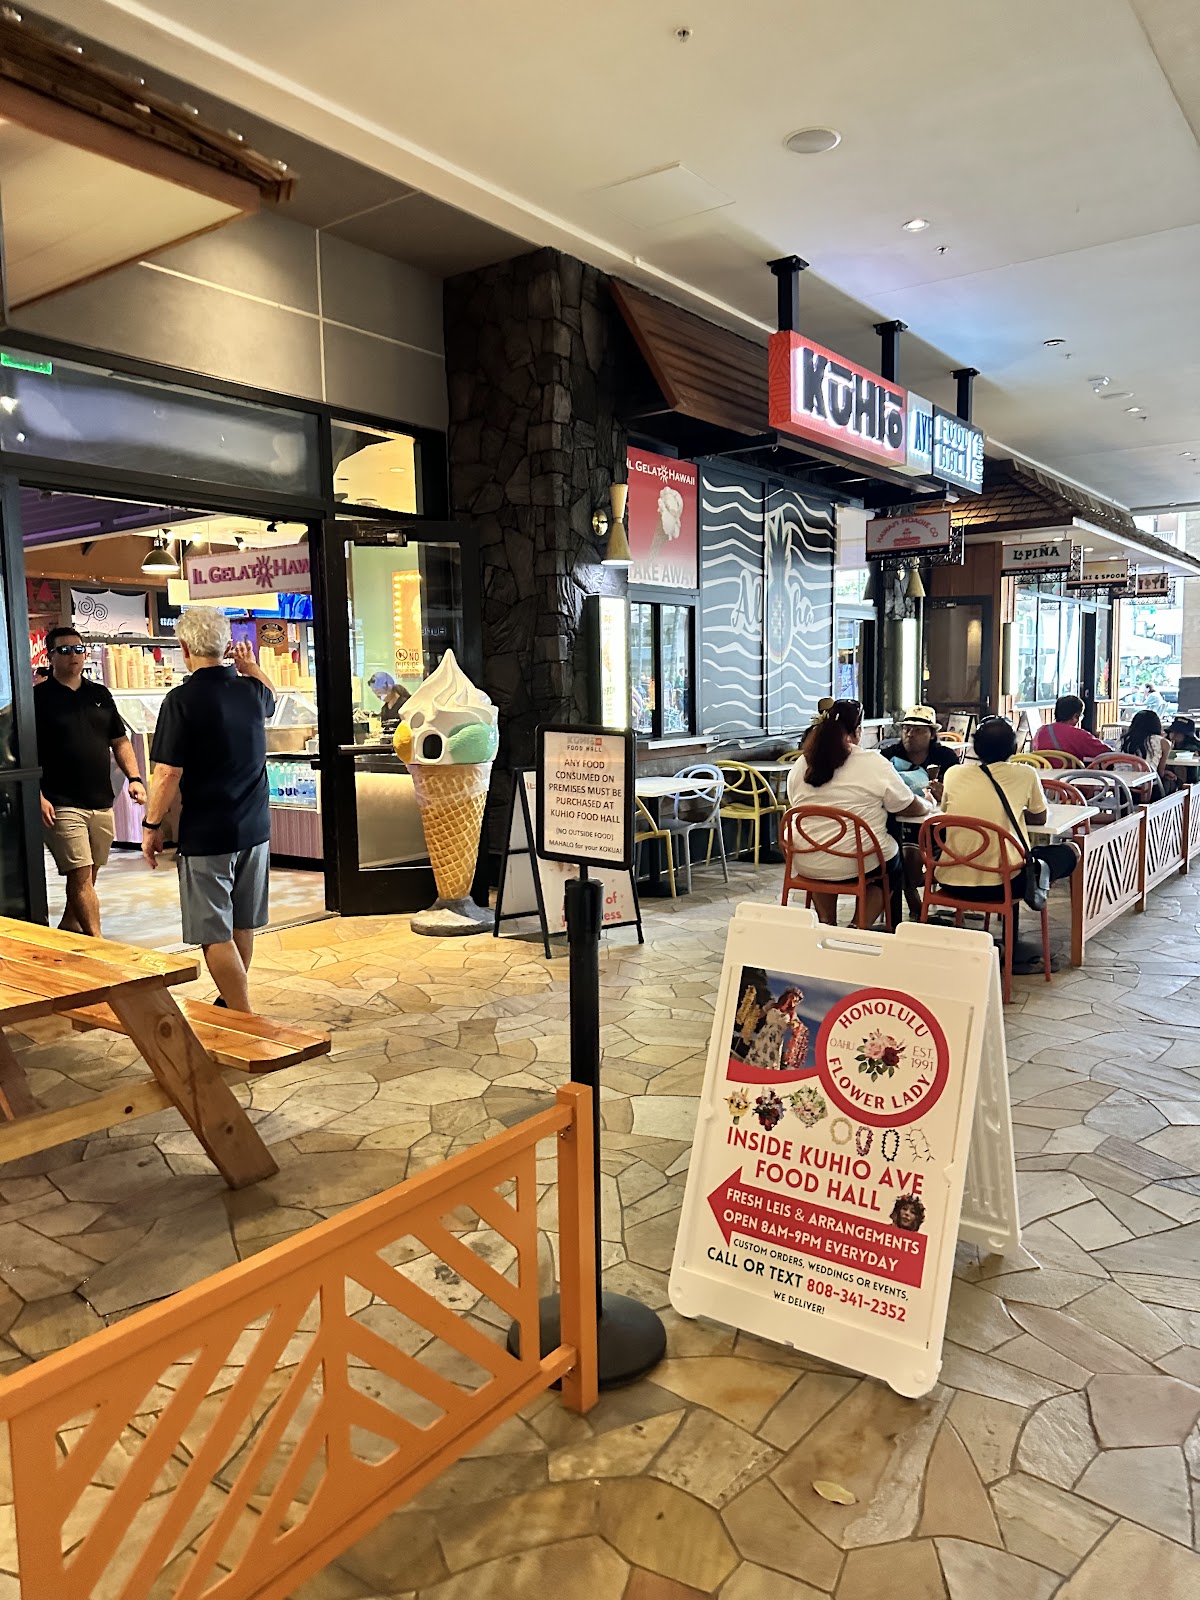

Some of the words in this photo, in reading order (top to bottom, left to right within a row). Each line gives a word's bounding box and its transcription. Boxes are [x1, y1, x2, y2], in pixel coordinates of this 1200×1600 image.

[635, 460, 668, 481] GELATO
[668, 469, 695, 486] HAWAII
[1024, 544, 1060, 560] PIÑA
[208, 559, 272, 586] GELATO
[273, 558, 310, 577] HAW
[564, 759, 581, 768] ANY
[582, 760, 605, 769] FOOD
[555, 770, 600, 783] CONSUMED
[602, 774, 615, 784] ON
[548, 782, 586, 794] PREMISES
[587, 786, 610, 796] MUST
[612, 788, 622, 798] BE
[556, 796, 601, 809] PURCHASED
[603, 801, 615, 810] AT
[550, 808, 575, 819] KUHIO
[576, 811, 599, 821] FOOD
[600, 814, 621, 824] HALL
[556, 827, 567, 836] (NO
[568, 828, 593, 838] OUTSIDE
[594, 832, 614, 841] FOOD)
[548, 839, 574, 848] MAHALO
[574, 841, 584, 849] for
[584, 844, 598, 852] your
[599, 845, 622, 855] KOKUA!
[605, 891, 617, 905] of
[838, 1001, 929, 1038] HONOLULU
[829, 1038, 856, 1051] OAHU
[912, 1045, 934, 1059] EST.
[911, 1058, 934, 1072] 1991
[828, 1057, 885, 1110] FLOWER
[891, 1073, 931, 1109] LADY
[727, 1126, 793, 1160] INSIDE
[799, 1145, 871, 1180] KUHIO
[878, 1166, 925, 1195] AVE
[755, 1159, 819, 1193] FOOD
[827, 1178, 881, 1212] HALL
[726, 1187, 763, 1210] FRESH
[766, 1198, 791, 1218] LEIS
[794, 1208, 805, 1222] &
[808, 1212, 920, 1255] ARRANGEMENTS
[723, 1209, 758, 1230] OPEN
[761, 1220, 822, 1250] 8AM-9PM
[825, 1239, 899, 1272] EVERYDAY
[733, 1238, 768, 1256] CUSTOM
[770, 1250, 805, 1268] ORDERS,
[807, 1261, 854, 1283] WEDDINGS
[856, 1276, 870, 1288] OR
[872, 1281, 909, 1302] EVENTS,
[707, 1246, 738, 1268] CALL
[743, 1258, 765, 1277] OR
[769, 1265, 803, 1289] TEXT
[807, 1278, 907, 1323] 808-341-2352
[773, 1290, 786, 1302] WE
[788, 1294, 825, 1315] DELIVER!
